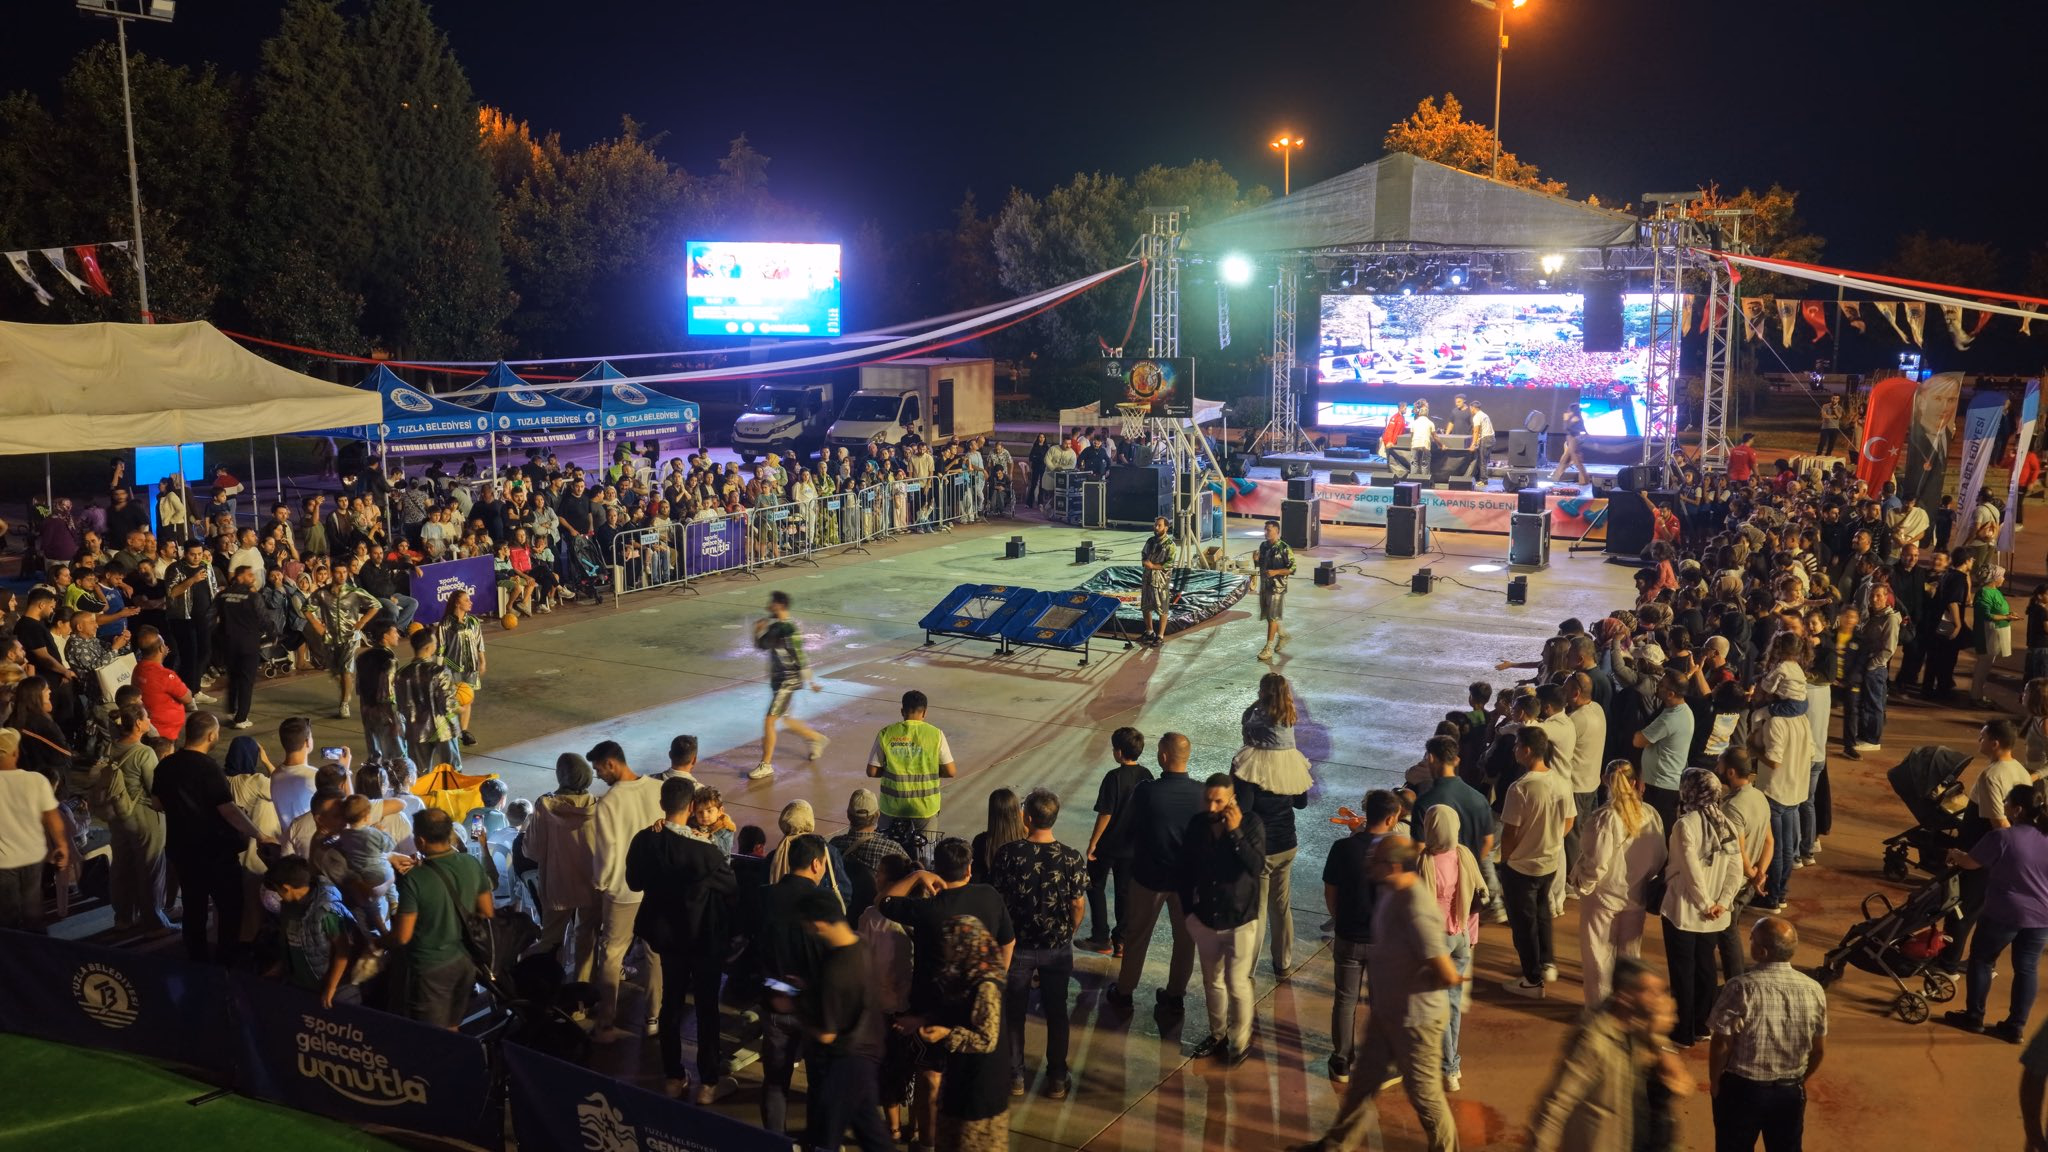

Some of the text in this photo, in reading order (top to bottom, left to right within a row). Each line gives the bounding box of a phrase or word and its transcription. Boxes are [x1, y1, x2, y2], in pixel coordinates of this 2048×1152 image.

[516, 414, 581, 426] TUZLA BELEDİYESİ
[622, 410, 680, 423] TUZLA BELEDİYESİ
[397, 419, 472, 434] TUZLA BELEDİYESİ
[1964, 416, 1986, 481] BELEDİYESİ
[1316, 491, 1333, 500] YILI
[1335, 492, 1352, 500] YAZ
[1354, 493, 1379, 503] SPOR
[1432, 499, 1476, 509] KAPANIŞ
[1478, 500, 1516, 511] ŞÖLENİ
[641, 534, 659, 543] TUZLA
[438, 576, 459, 586] sporla
[72, 966, 88, 997] TUZLA
[301, 1014, 364, 1042] sporla
[296, 1032, 389, 1070] geleceğe
[644, 1126, 670, 1140] TUZLA
